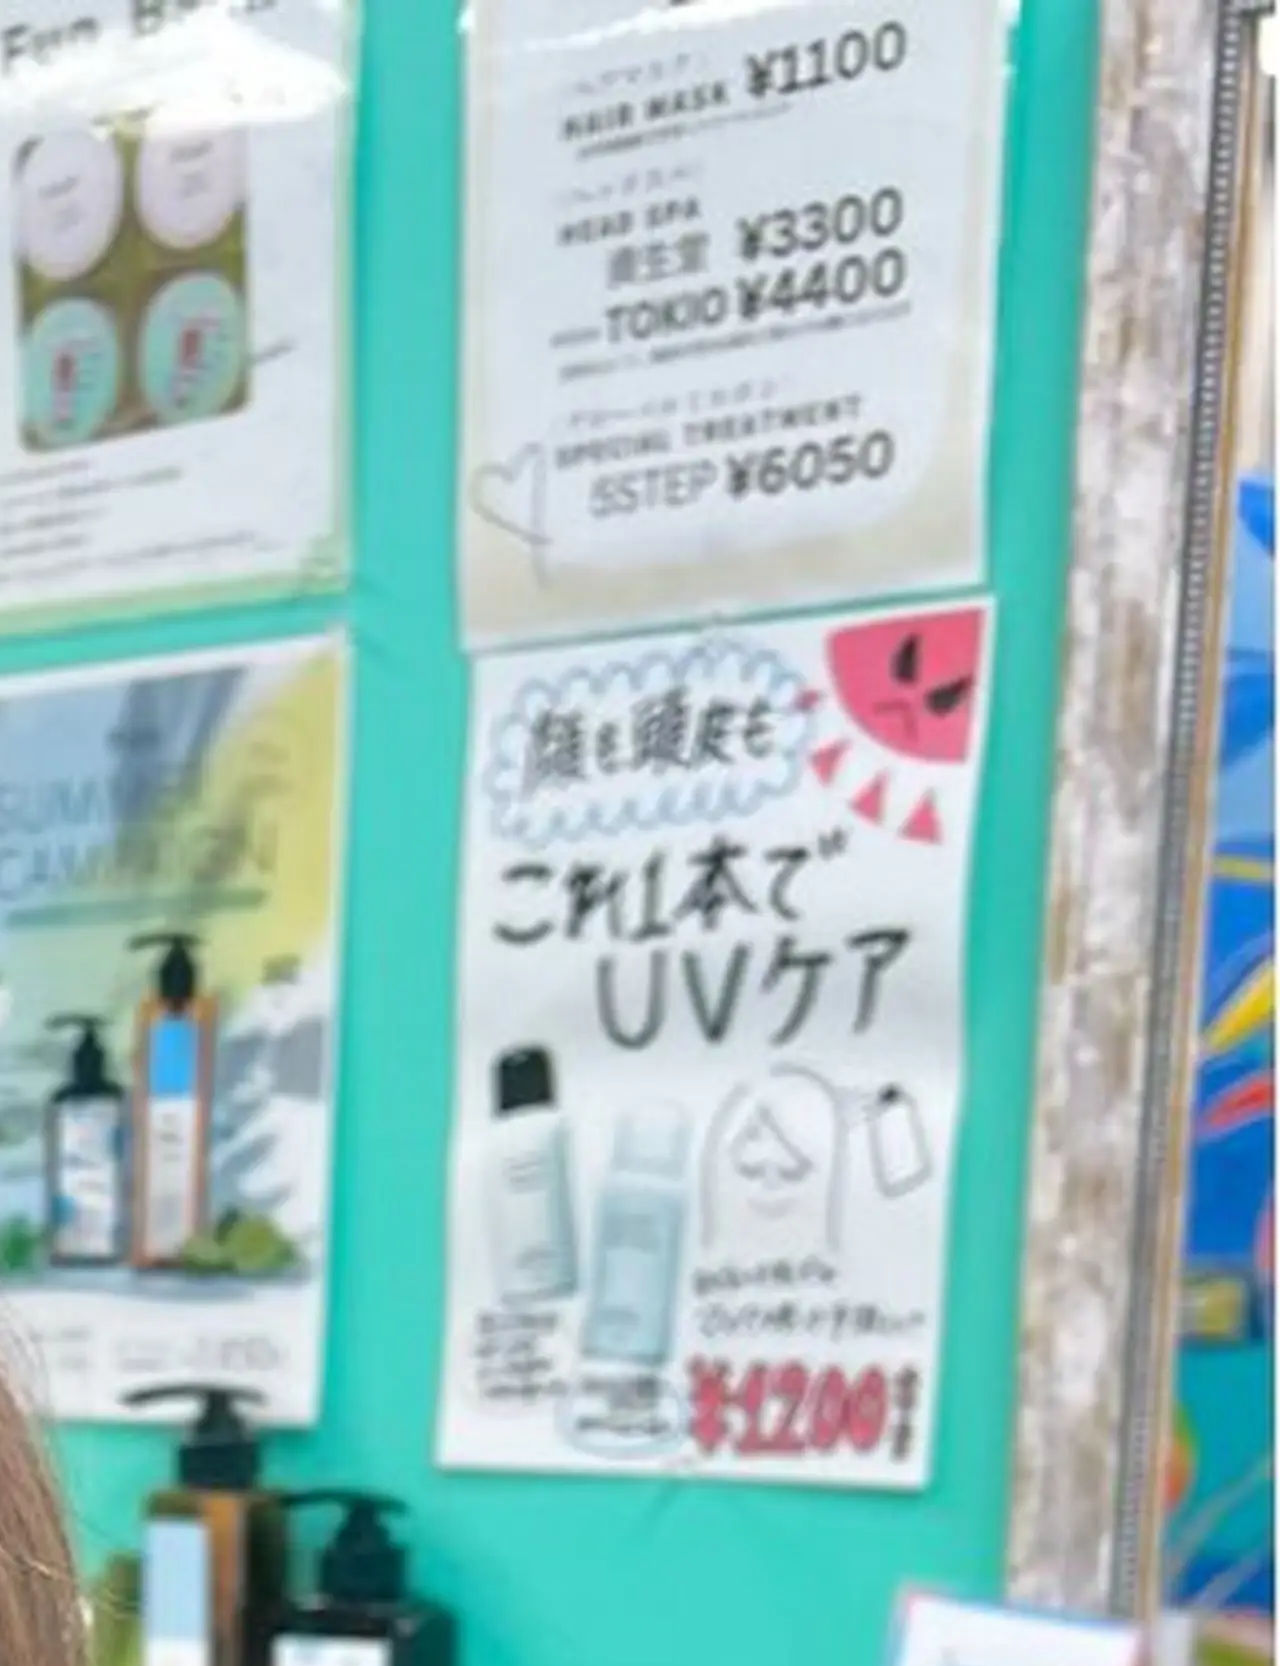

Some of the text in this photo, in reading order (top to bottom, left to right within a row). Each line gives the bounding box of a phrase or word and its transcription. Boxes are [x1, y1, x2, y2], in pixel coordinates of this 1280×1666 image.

[561, 100, 635, 142] HAIR
[646, 84, 731, 124] MASK
[745, 20, 908, 98] ¥1100
[556, 196, 703, 247] HEAD SPA
[736, 185, 906, 264] ¥3300
[605, 287, 729, 346] TOKIO
[736, 246, 908, 323] ¥4400
[554, 393, 865, 471] SPECIAL TREATMENT
[588, 428, 896, 519] 5STEP ¥6050
[526, 684, 777, 788] 顔も頭皮も
[494, 829, 850, 946] これ1本で
[595, 925, 914, 1050] UVケア
